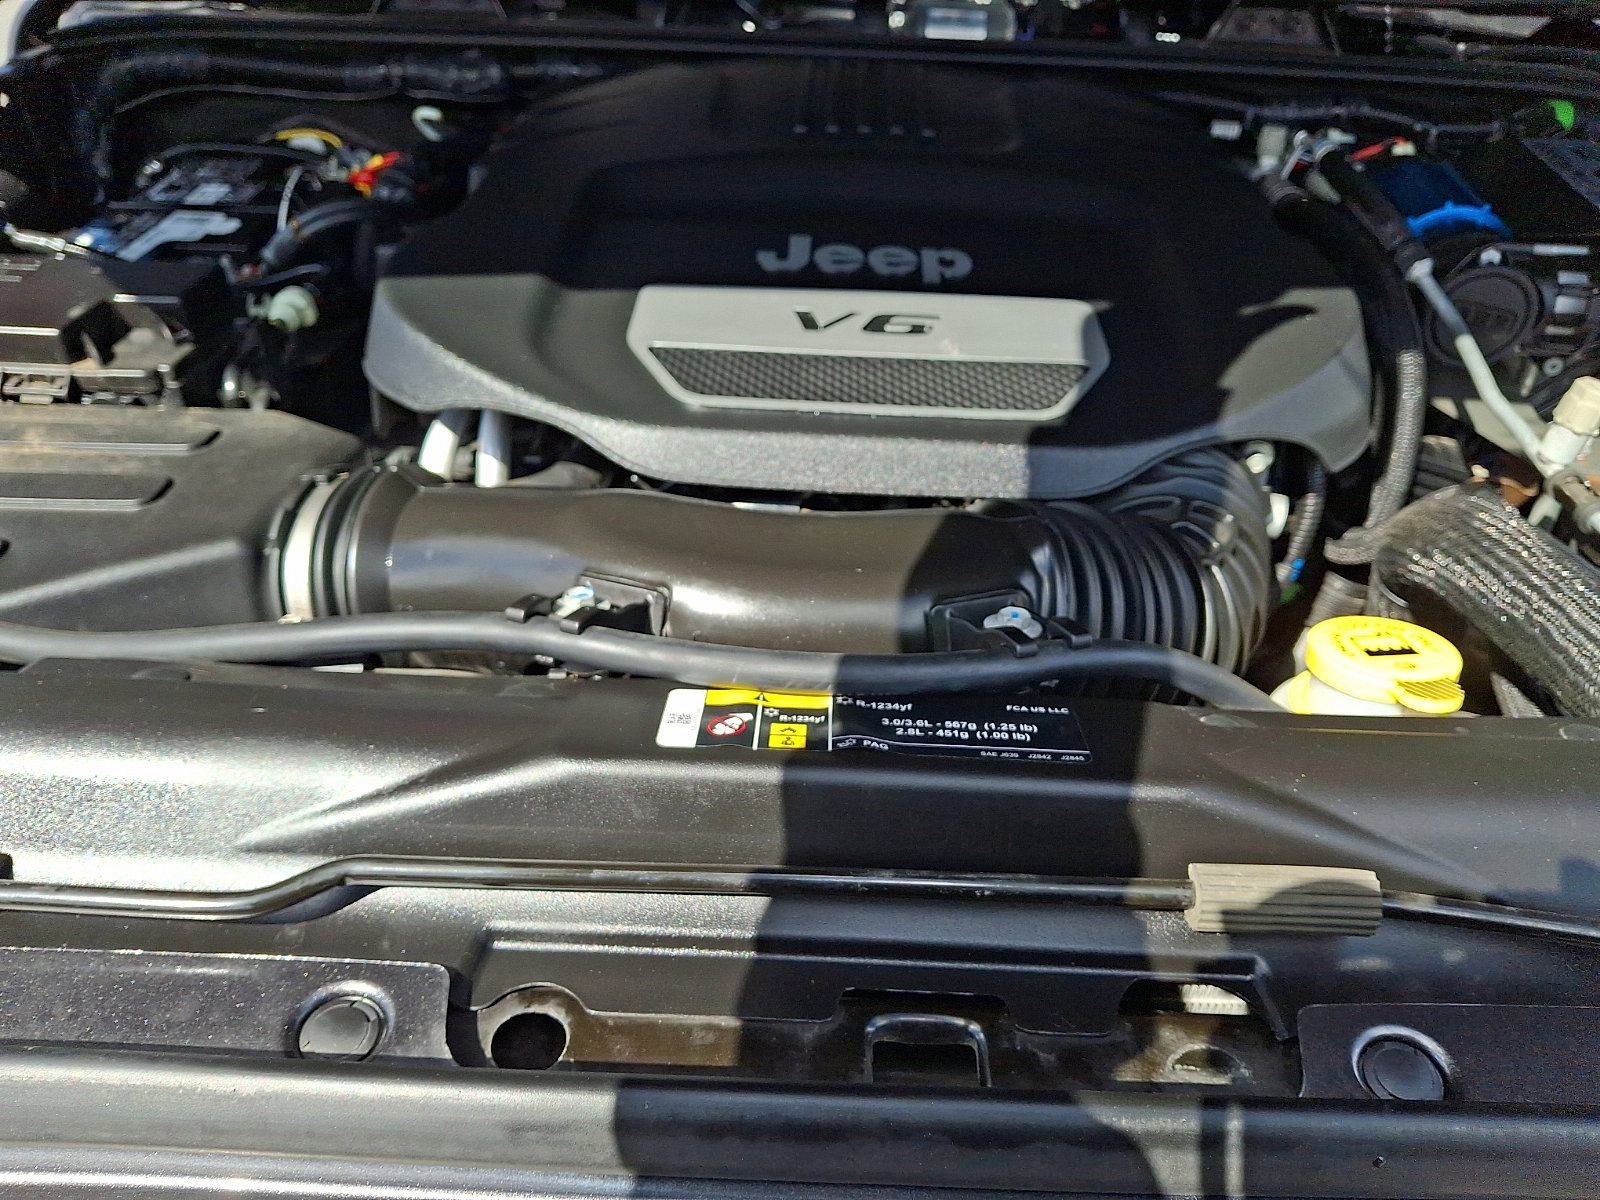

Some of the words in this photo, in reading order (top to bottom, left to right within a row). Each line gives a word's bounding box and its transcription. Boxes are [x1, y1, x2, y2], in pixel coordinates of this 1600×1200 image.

[756, 233, 973, 284] Jeep
[795, 310, 940, 334] V6
[856, 699, 913, 711] R-1234yf
[778, 713, 826, 723] R-1234yf
[881, 717, 933, 727] 3.0/3.6L
[984, 721, 1017, 731] (1.25
[1019, 723, 1039, 733] lb)
[935, 729, 969, 739] 451g
[976, 730, 1010, 740] (1.00
[1012, 732, 1031, 742] lb)
